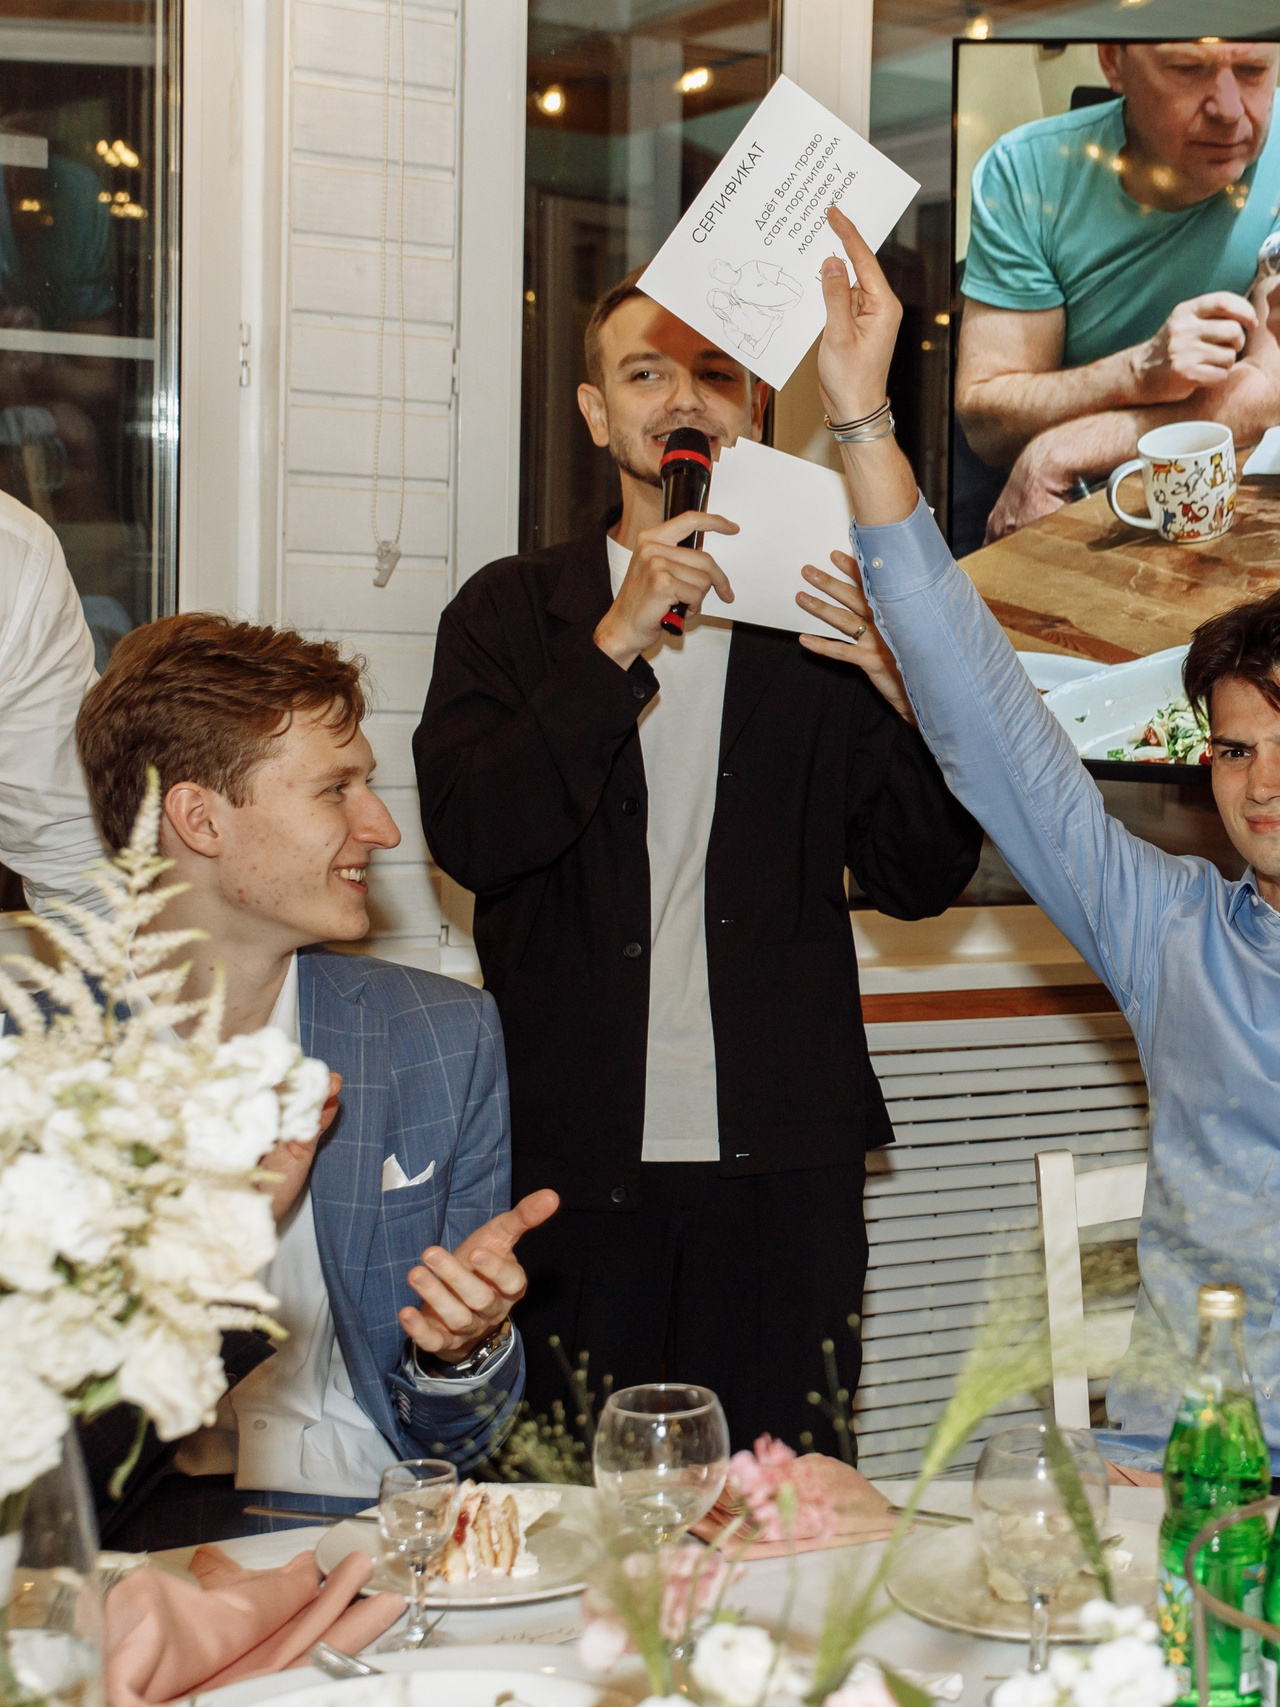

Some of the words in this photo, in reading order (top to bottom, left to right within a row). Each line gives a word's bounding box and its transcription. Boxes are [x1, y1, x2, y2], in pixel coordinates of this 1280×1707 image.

[692, 141, 765, 244] СЕРТИФИКАТ
[755, 197, 779, 231] Даёт
[774, 172, 798, 199] Вам
[794, 133, 823, 171] право
[763, 216, 788, 246] стать
[785, 137, 841, 215] поручителем
[788, 222, 802, 239] по
[800, 173, 835, 222] ипотеке
[832, 163, 843, 174] у
